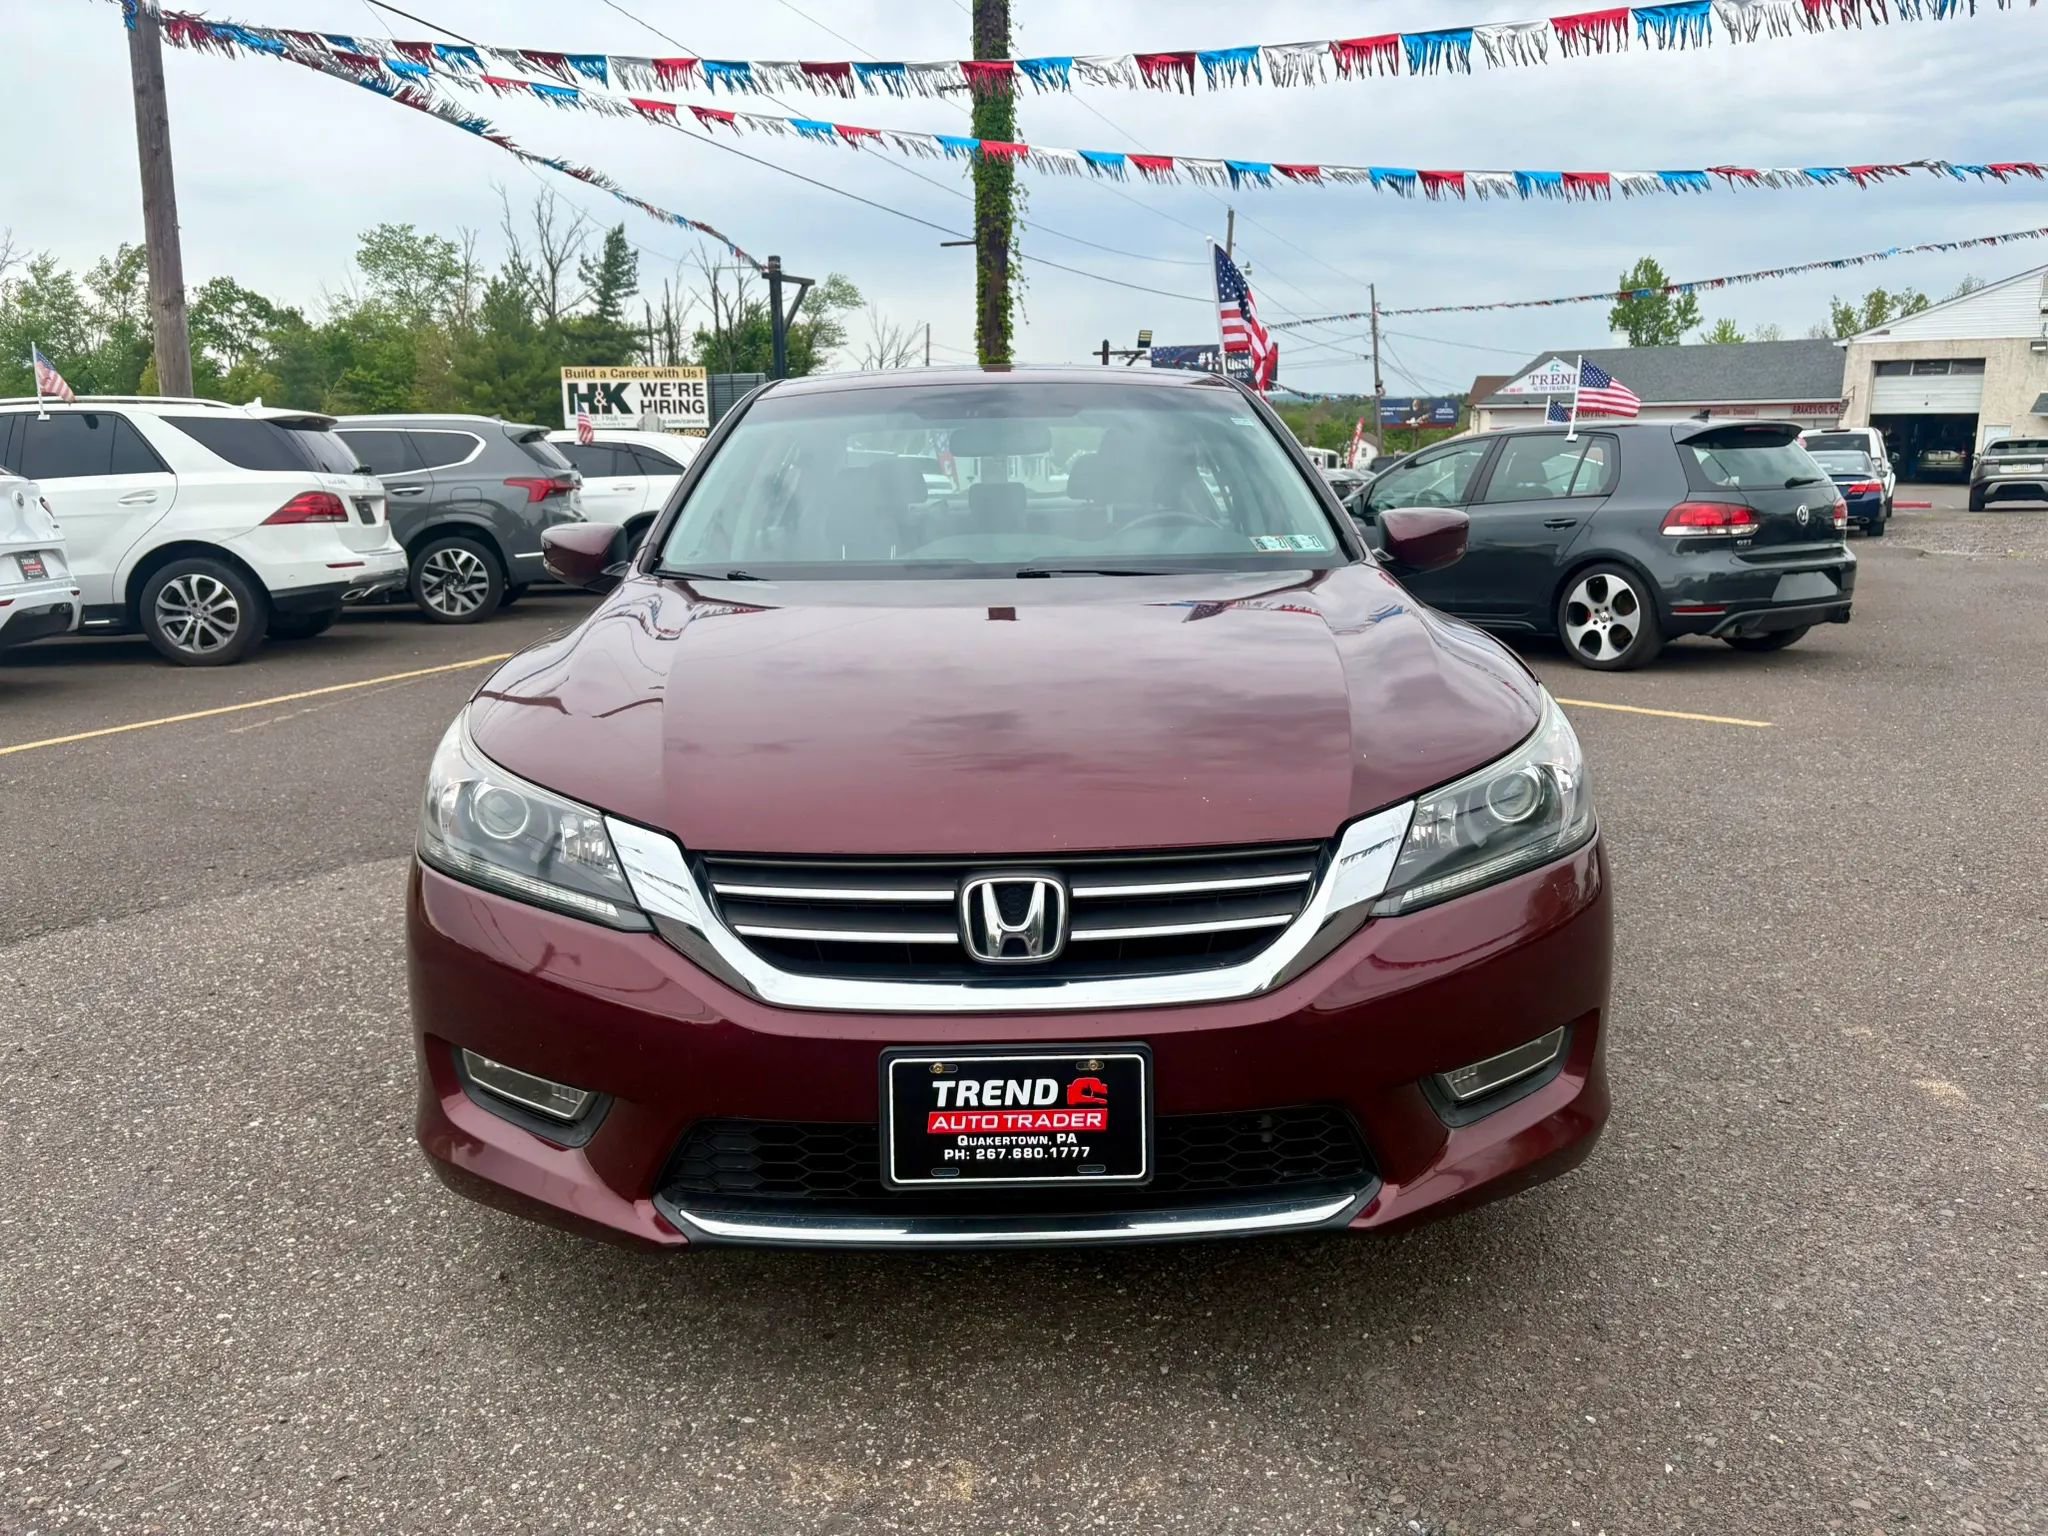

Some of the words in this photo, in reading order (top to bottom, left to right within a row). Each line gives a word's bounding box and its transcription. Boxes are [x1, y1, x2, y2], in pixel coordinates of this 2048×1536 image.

[565, 368, 596, 379] Build
[610, 368, 649, 379] Career
[653, 368, 679, 379] with
[640, 382, 704, 398] WE'RE
[567, 382, 634, 415] H&K
[640, 399, 705, 415] HIRING
[932, 1078, 1059, 1108] TREND
[931, 1114, 999, 1130] AUTO
[1003, 1112, 1103, 1128] TRADER
[1056, 1132, 1078, 1145] PA
[944, 1149, 971, 1161] PH:
[976, 1146, 1091, 1160] 267.680.1777
